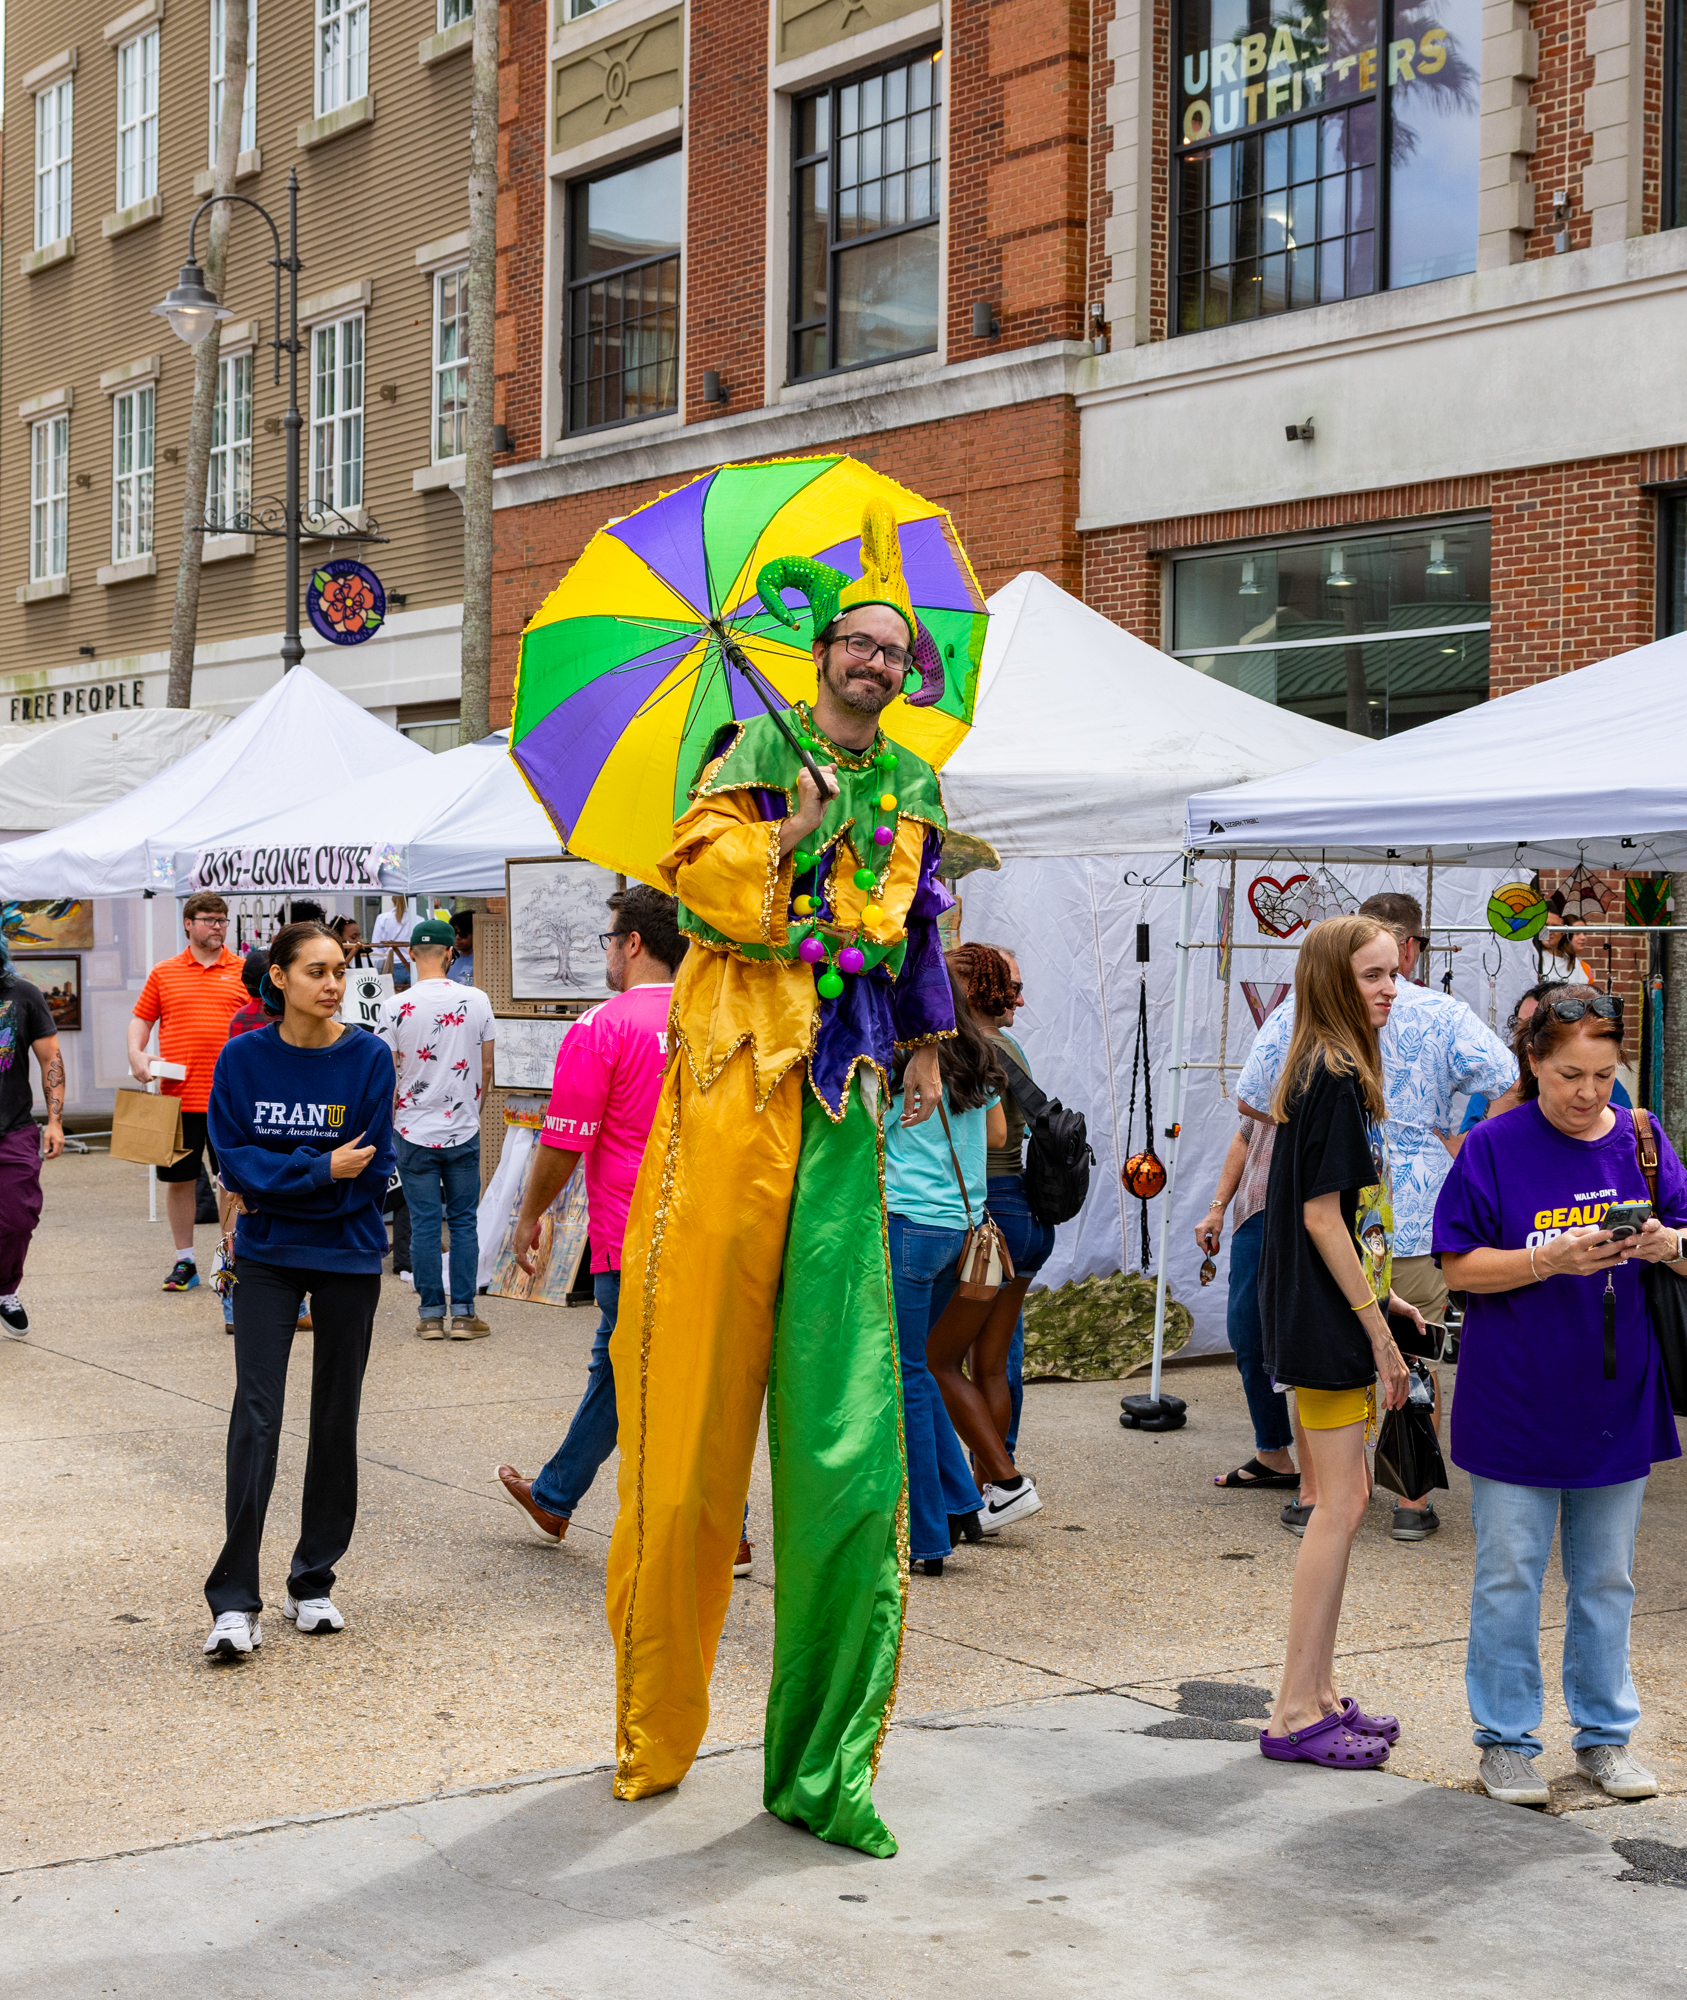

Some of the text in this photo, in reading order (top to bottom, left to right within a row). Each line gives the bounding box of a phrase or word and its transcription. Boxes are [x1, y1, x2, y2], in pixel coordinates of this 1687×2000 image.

[1183, 28, 1447, 143] OUTFITTERS
[10, 680, 144, 722] FREE PEOPLE
[200, 845, 373, 887] DOG-GONE CUTE
[253, 1101, 346, 1127] FRANU
[542, 1115, 577, 1134] WIFT
[255, 1125, 339, 1138] Nurse Anesthesia
